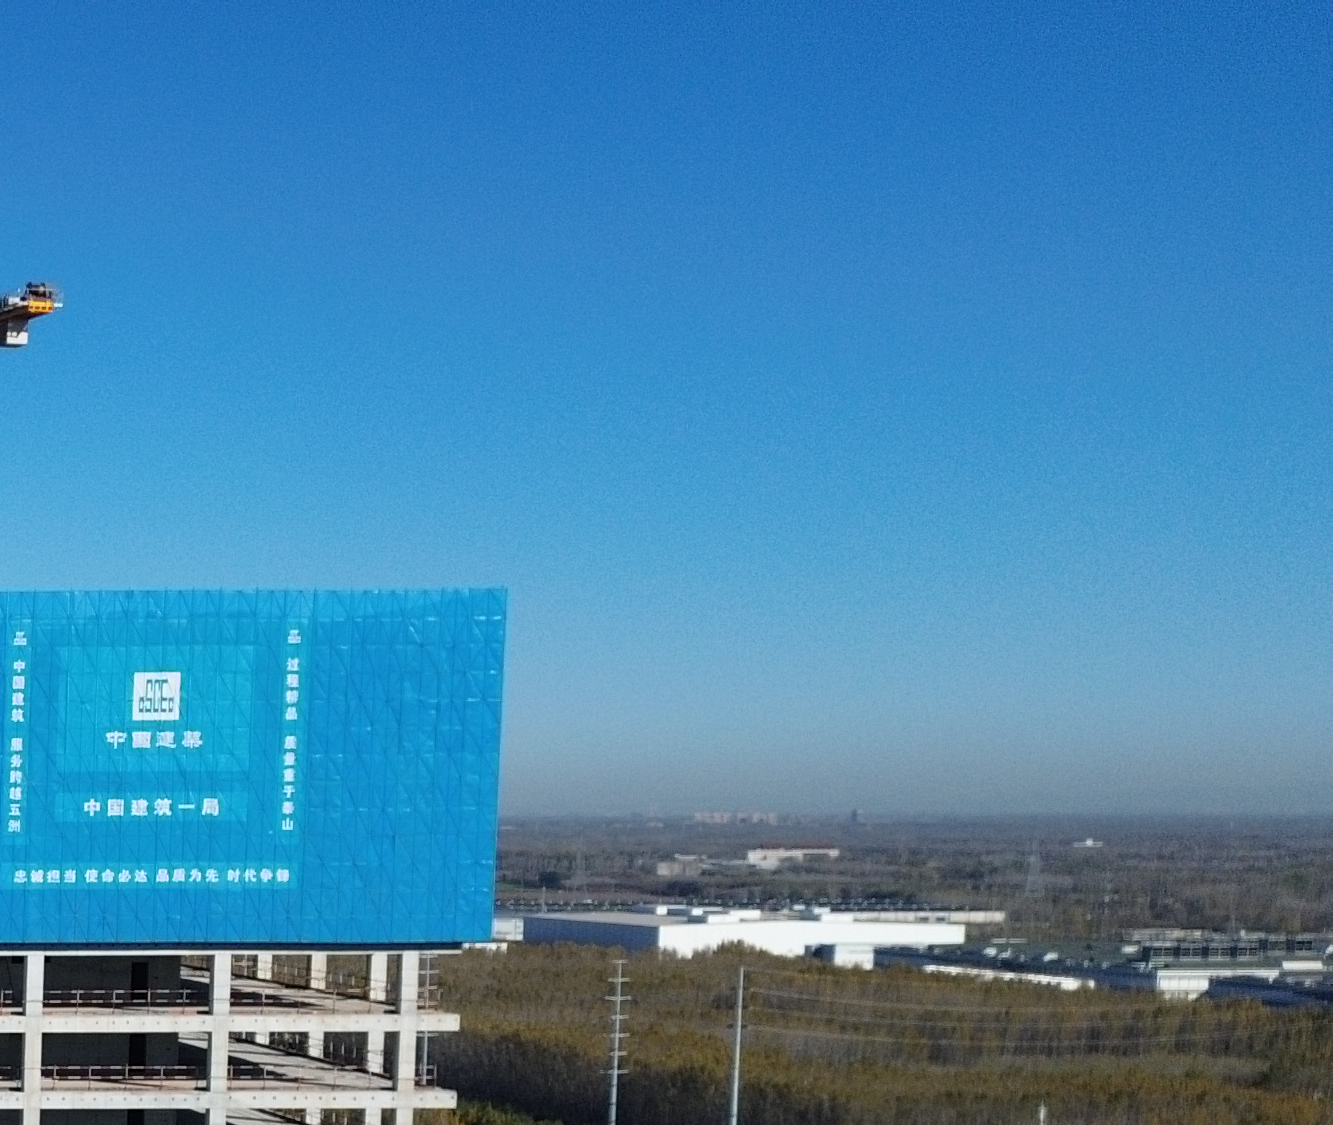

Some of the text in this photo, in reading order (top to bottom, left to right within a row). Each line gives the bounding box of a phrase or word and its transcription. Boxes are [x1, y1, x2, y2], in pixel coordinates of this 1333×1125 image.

[11, 659, 26, 723] 中国建筑
[83, 797, 220, 817] 中国建筑一局
[13, 869, 77, 884] 忠诚担当
[84, 868, 148, 883] 使命必达
[155, 867, 220, 883] 品质为先
